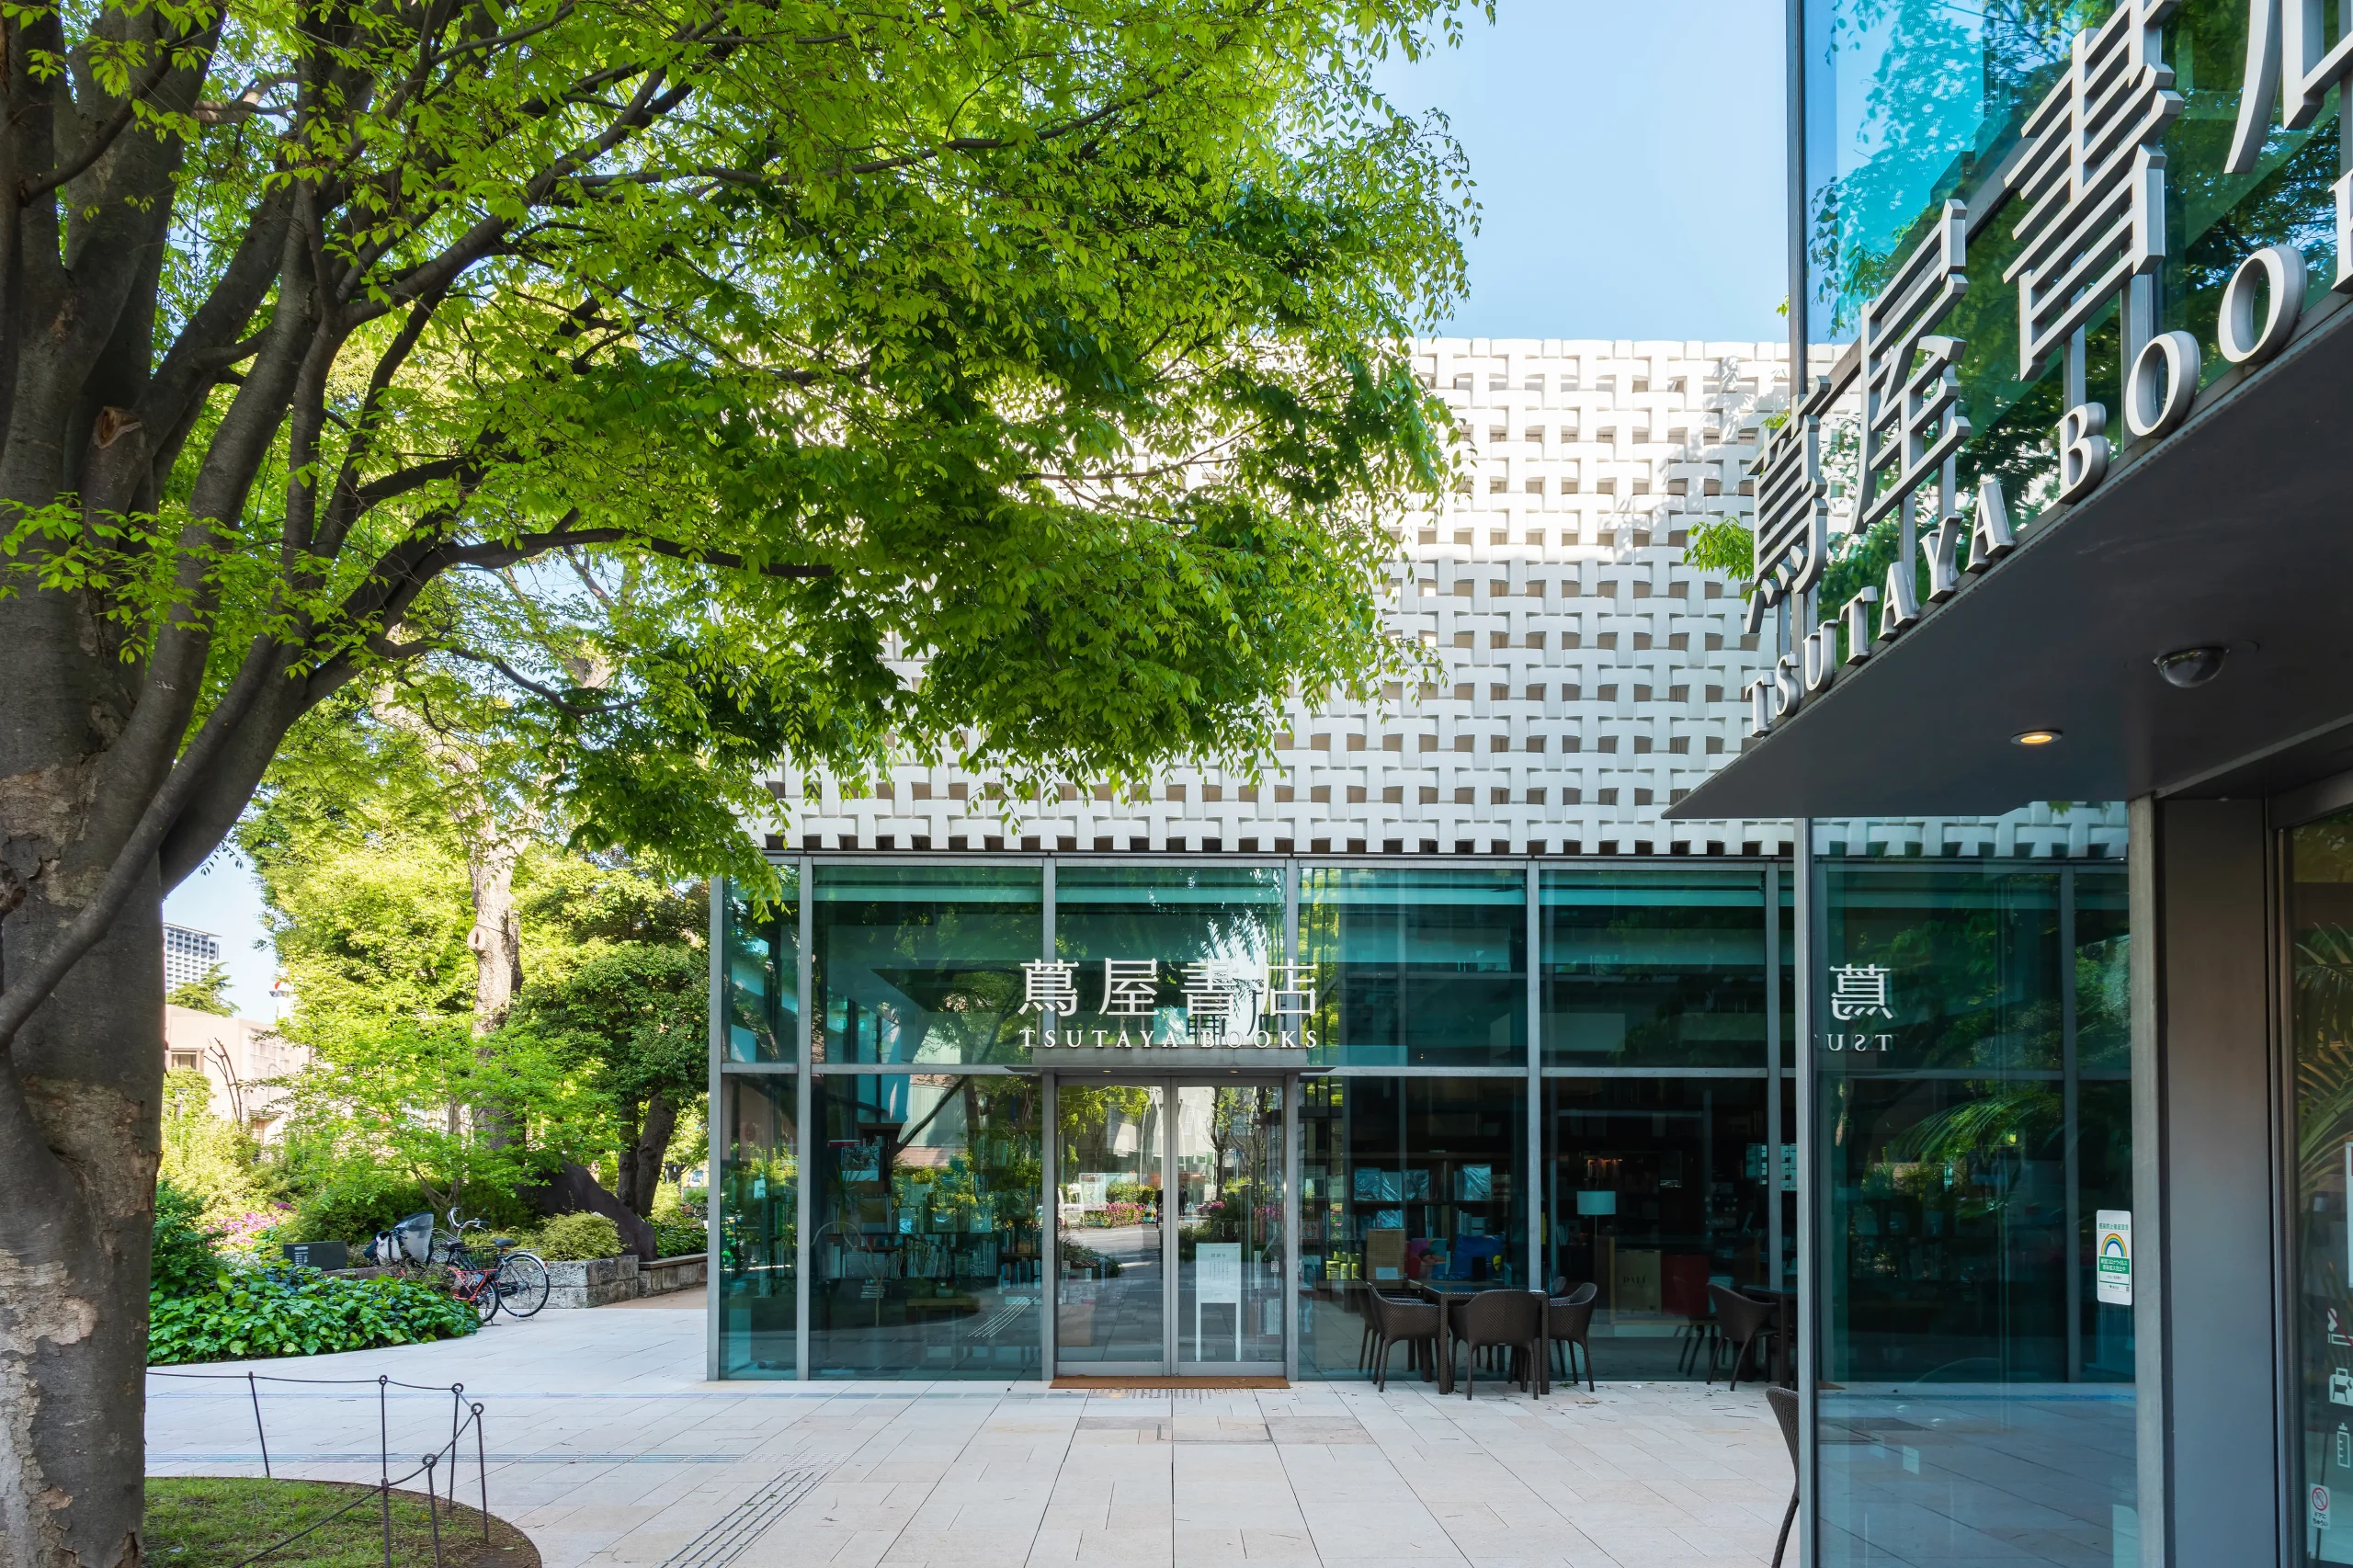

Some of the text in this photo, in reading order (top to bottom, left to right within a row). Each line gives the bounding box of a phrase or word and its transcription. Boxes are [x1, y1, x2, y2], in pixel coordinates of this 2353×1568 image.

[1745, 167, 2353, 738] TSUTAYA BOO
[1017, 957, 1318, 1017] 蔦屋書店
[1018, 1029, 1318, 1049] TSUTAYA BOOKS
